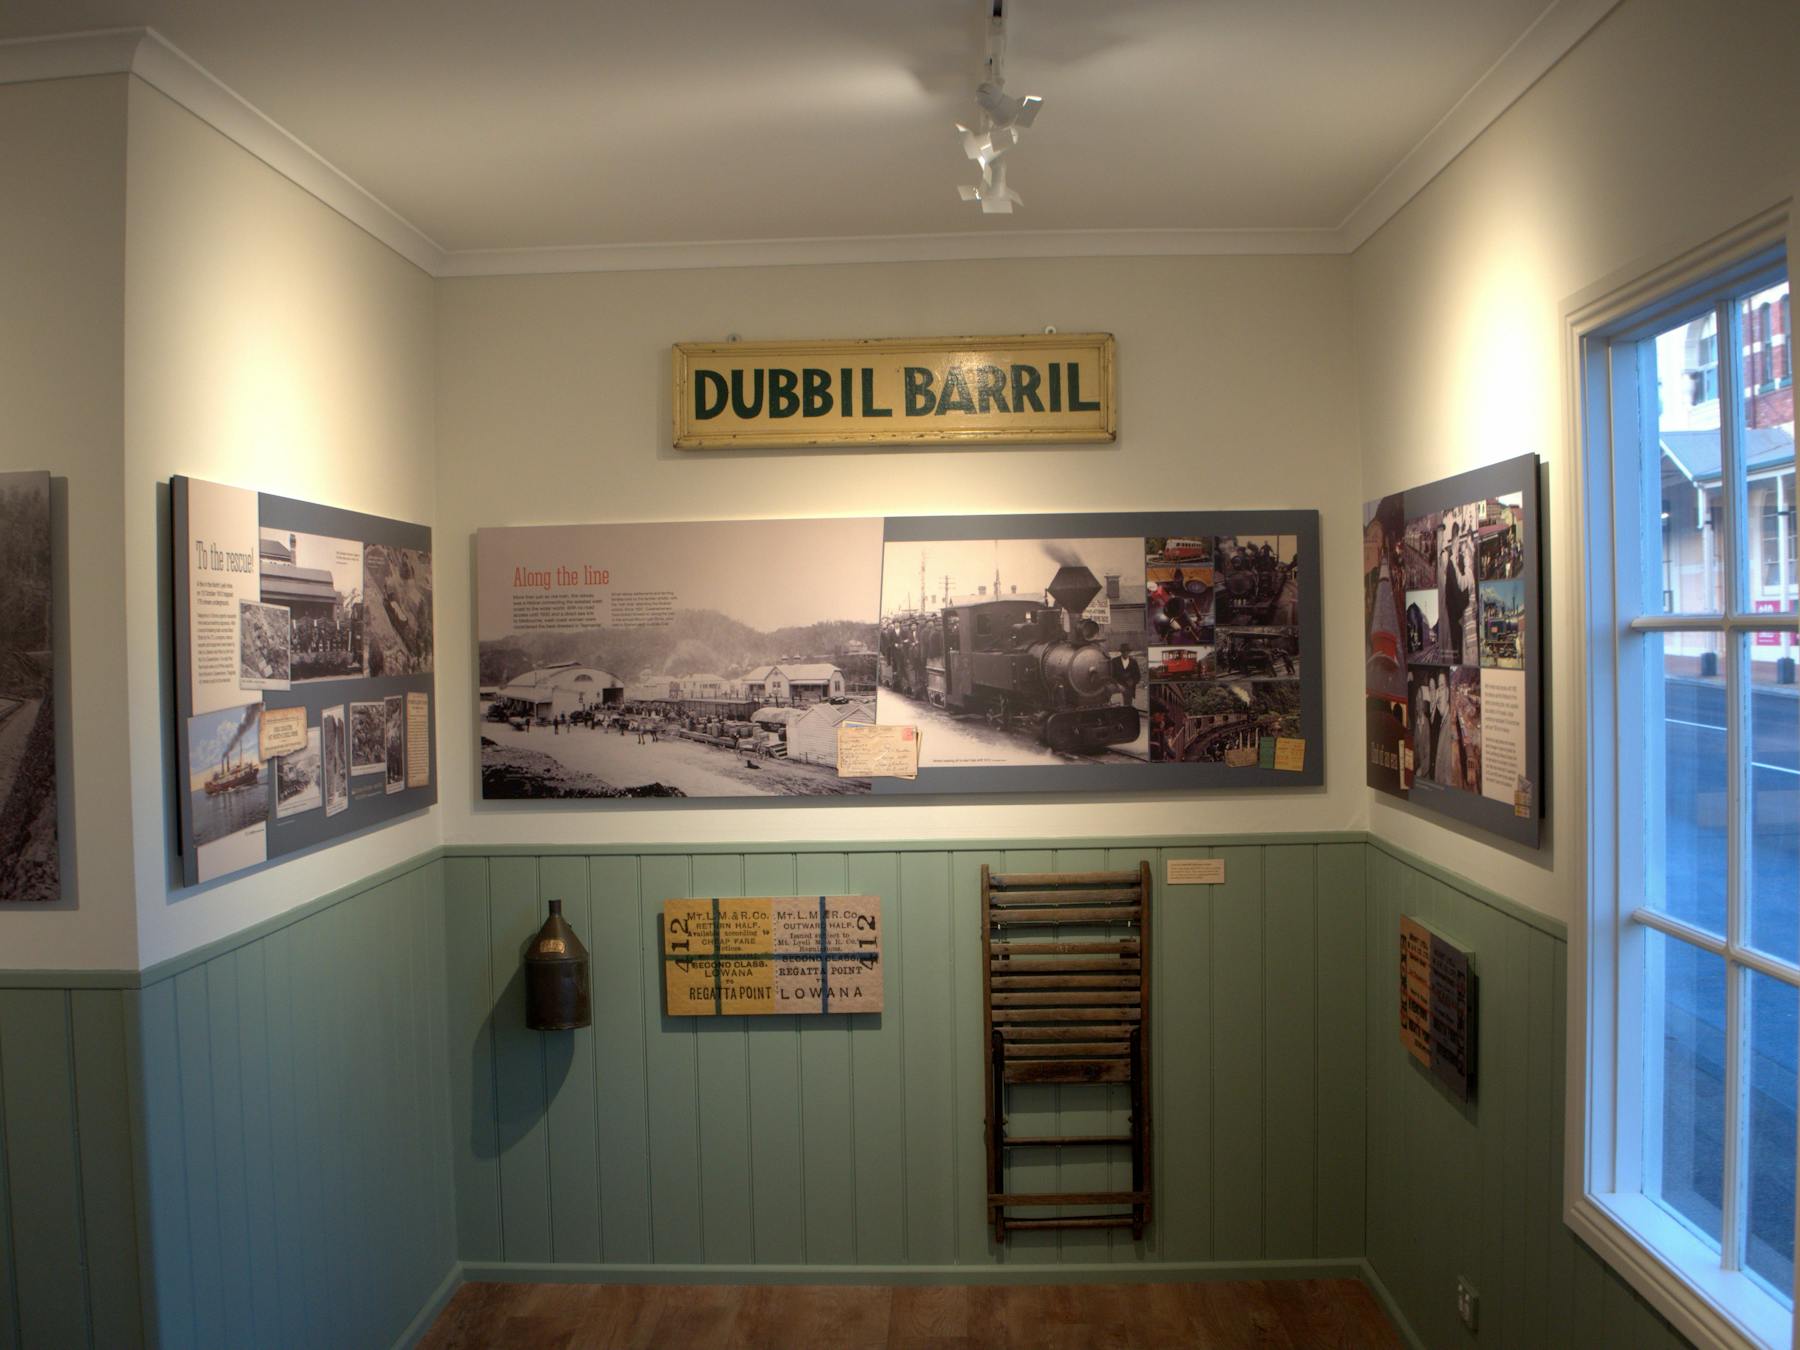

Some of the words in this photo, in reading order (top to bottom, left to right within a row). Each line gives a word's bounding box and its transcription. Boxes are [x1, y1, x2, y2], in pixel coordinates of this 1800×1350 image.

[694, 367, 893, 421] DUBBIL
[903, 362, 1101, 417] BARRIL
[196, 540, 208, 570] To
[210, 542, 223, 571] the
[226, 546, 254, 573] rescue!
[513, 566, 551, 591] Along
[557, 565, 578, 586] the
[584, 564, 609, 585] line
[696, 922, 731, 930] RETRN
[783, 922, 827, 930] OUTWAR
[779, 967, 827, 976] REGATTA
[830, 966, 863, 975] POINT
[689, 987, 737, 1000] REGATTA
[739, 986, 772, 999] POINT
[780, 986, 863, 1000] LOWANA
